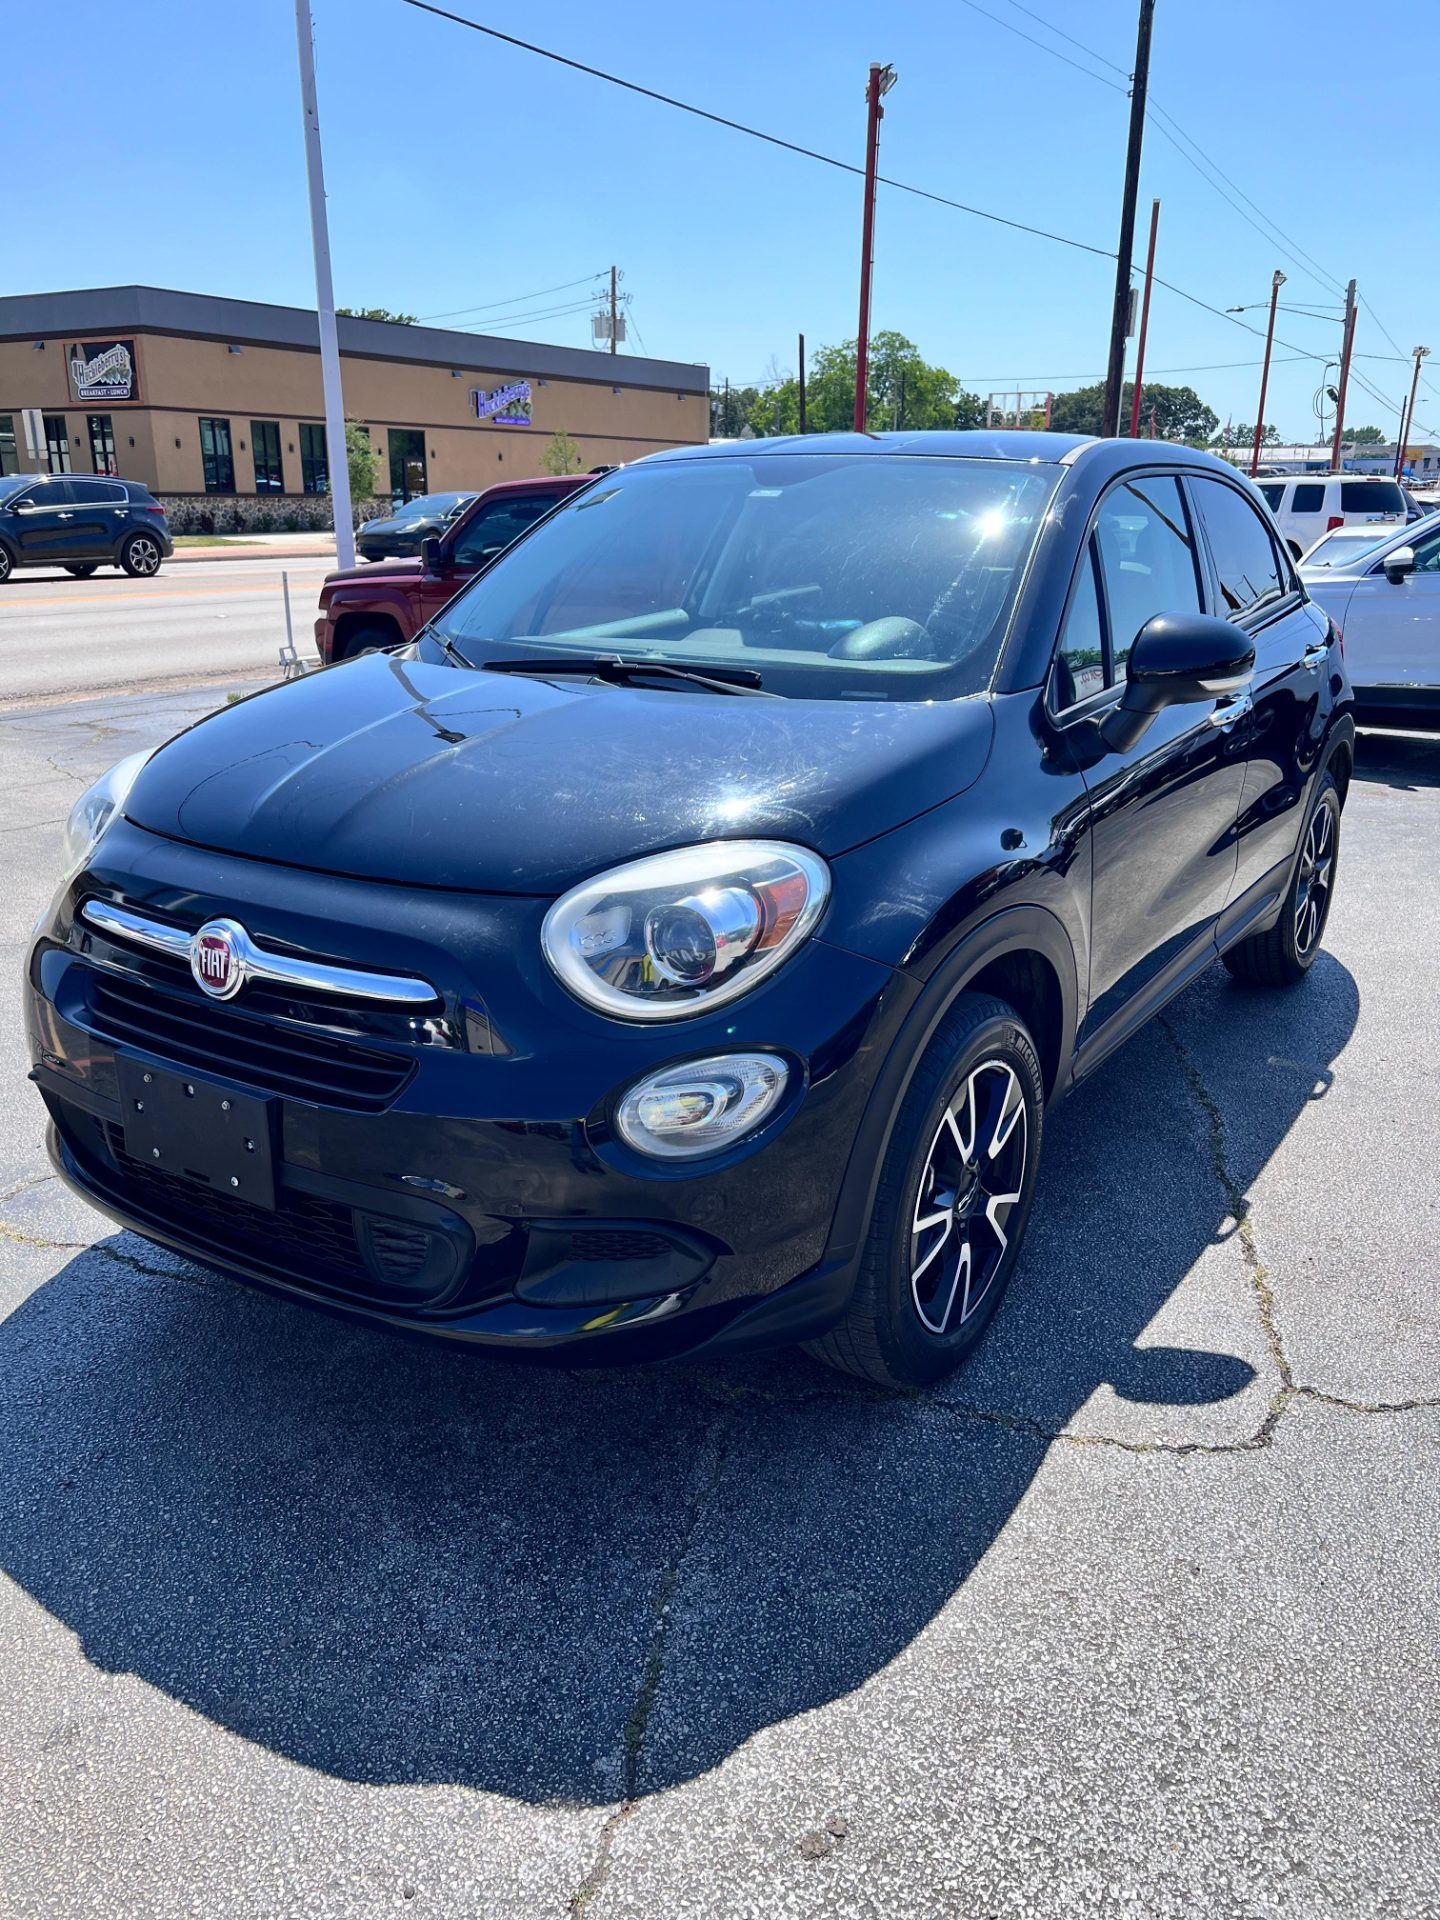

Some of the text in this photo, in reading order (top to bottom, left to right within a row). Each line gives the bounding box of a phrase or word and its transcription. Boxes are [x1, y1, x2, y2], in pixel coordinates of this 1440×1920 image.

[81, 388, 127, 397] BREAKFAST LUNCH
[201, 945, 228, 979] FIAT
[1015, 1036, 1042, 1102] MICHELIN
